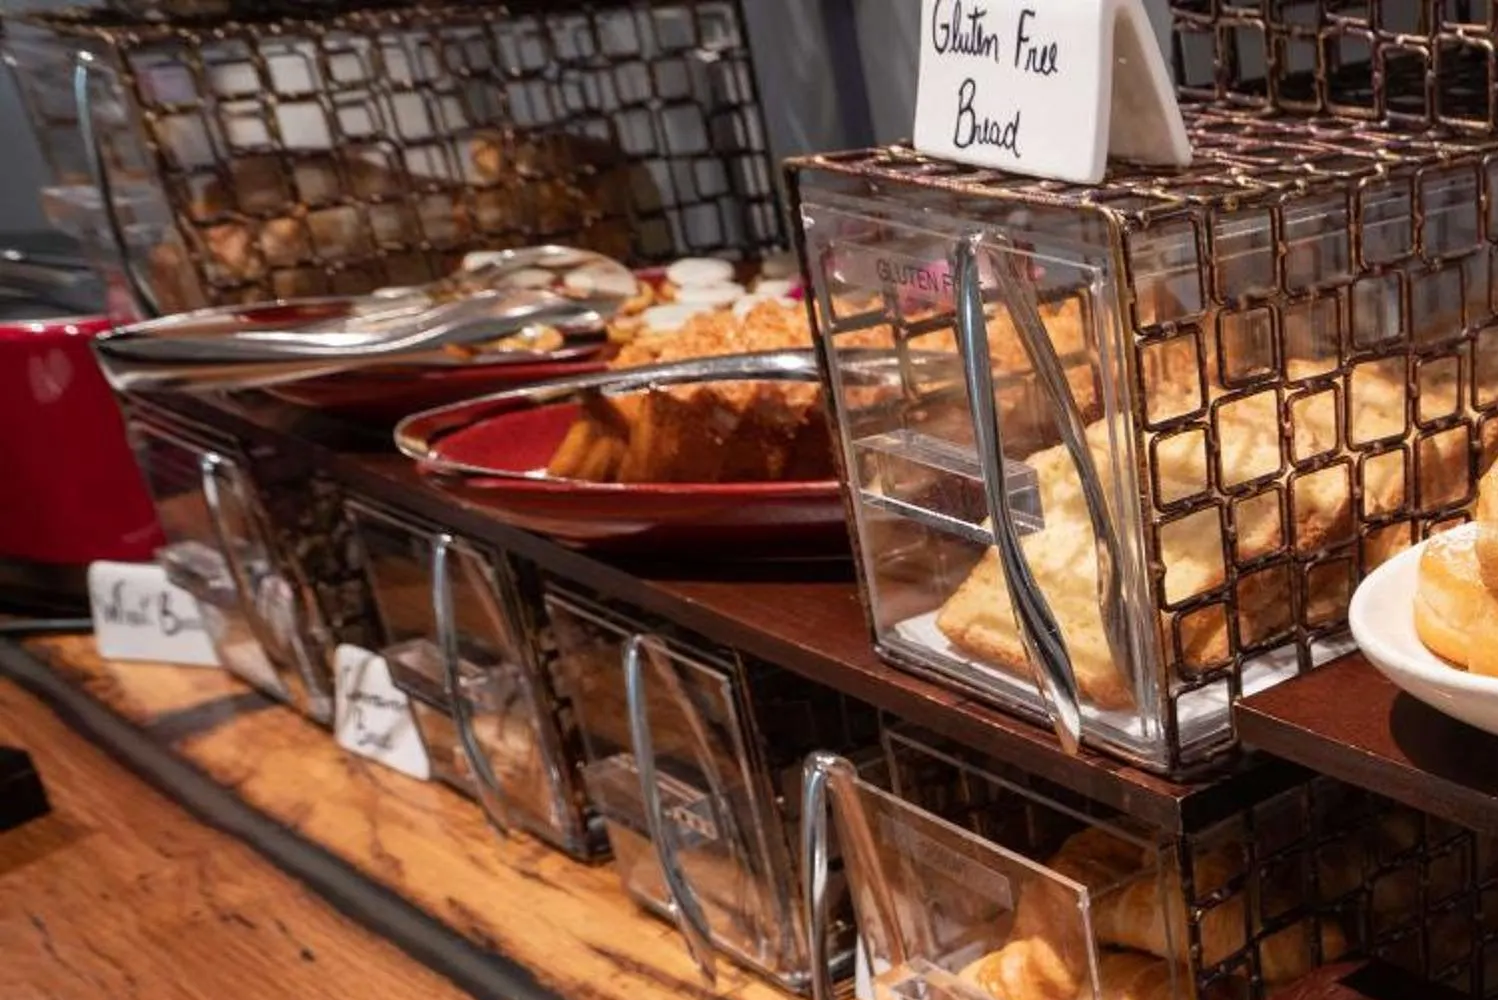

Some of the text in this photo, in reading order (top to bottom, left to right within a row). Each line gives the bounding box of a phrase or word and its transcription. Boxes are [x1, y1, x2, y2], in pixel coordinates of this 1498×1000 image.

[932, 0, 1058, 76] Gluten Free
[954, 77, 1021, 158] Bread
[876, 257, 940, 292] GLUTEN
